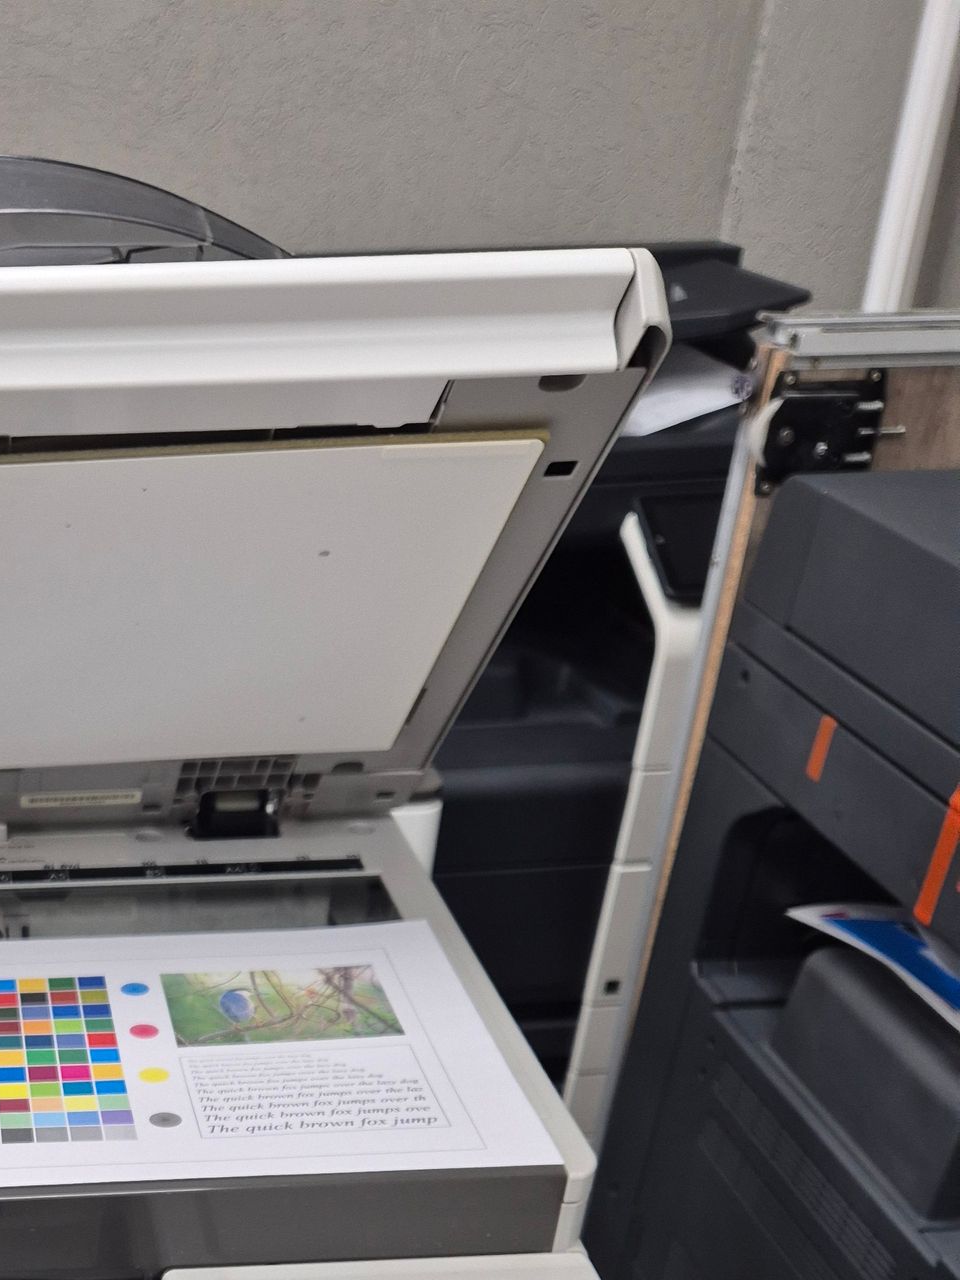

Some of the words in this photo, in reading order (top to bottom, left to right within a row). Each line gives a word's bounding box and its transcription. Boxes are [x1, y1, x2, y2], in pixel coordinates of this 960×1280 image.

[201, 1104, 225, 1112] The
[228, 1103, 264, 1113] quick
[269, 1101, 309, 1109] brown
[313, 1099, 333, 1107] fox
[337, 1097, 376, 1107] jumps
[414, 1094, 427, 1102] th
[205, 1114, 231, 1122] The
[235, 1112, 275, 1122] quick
[280, 1110, 326, 1118] brown
[331, 1108, 352, 1117] fox
[357, 1105, 401, 1115] jumps
[208, 1124, 239, 1134] The
[246, 1121, 293, 1134] quick
[300, 1119, 354, 1129] brown
[361, 1117, 388, 1128] fox
[393, 1116, 438, 1126] jump
